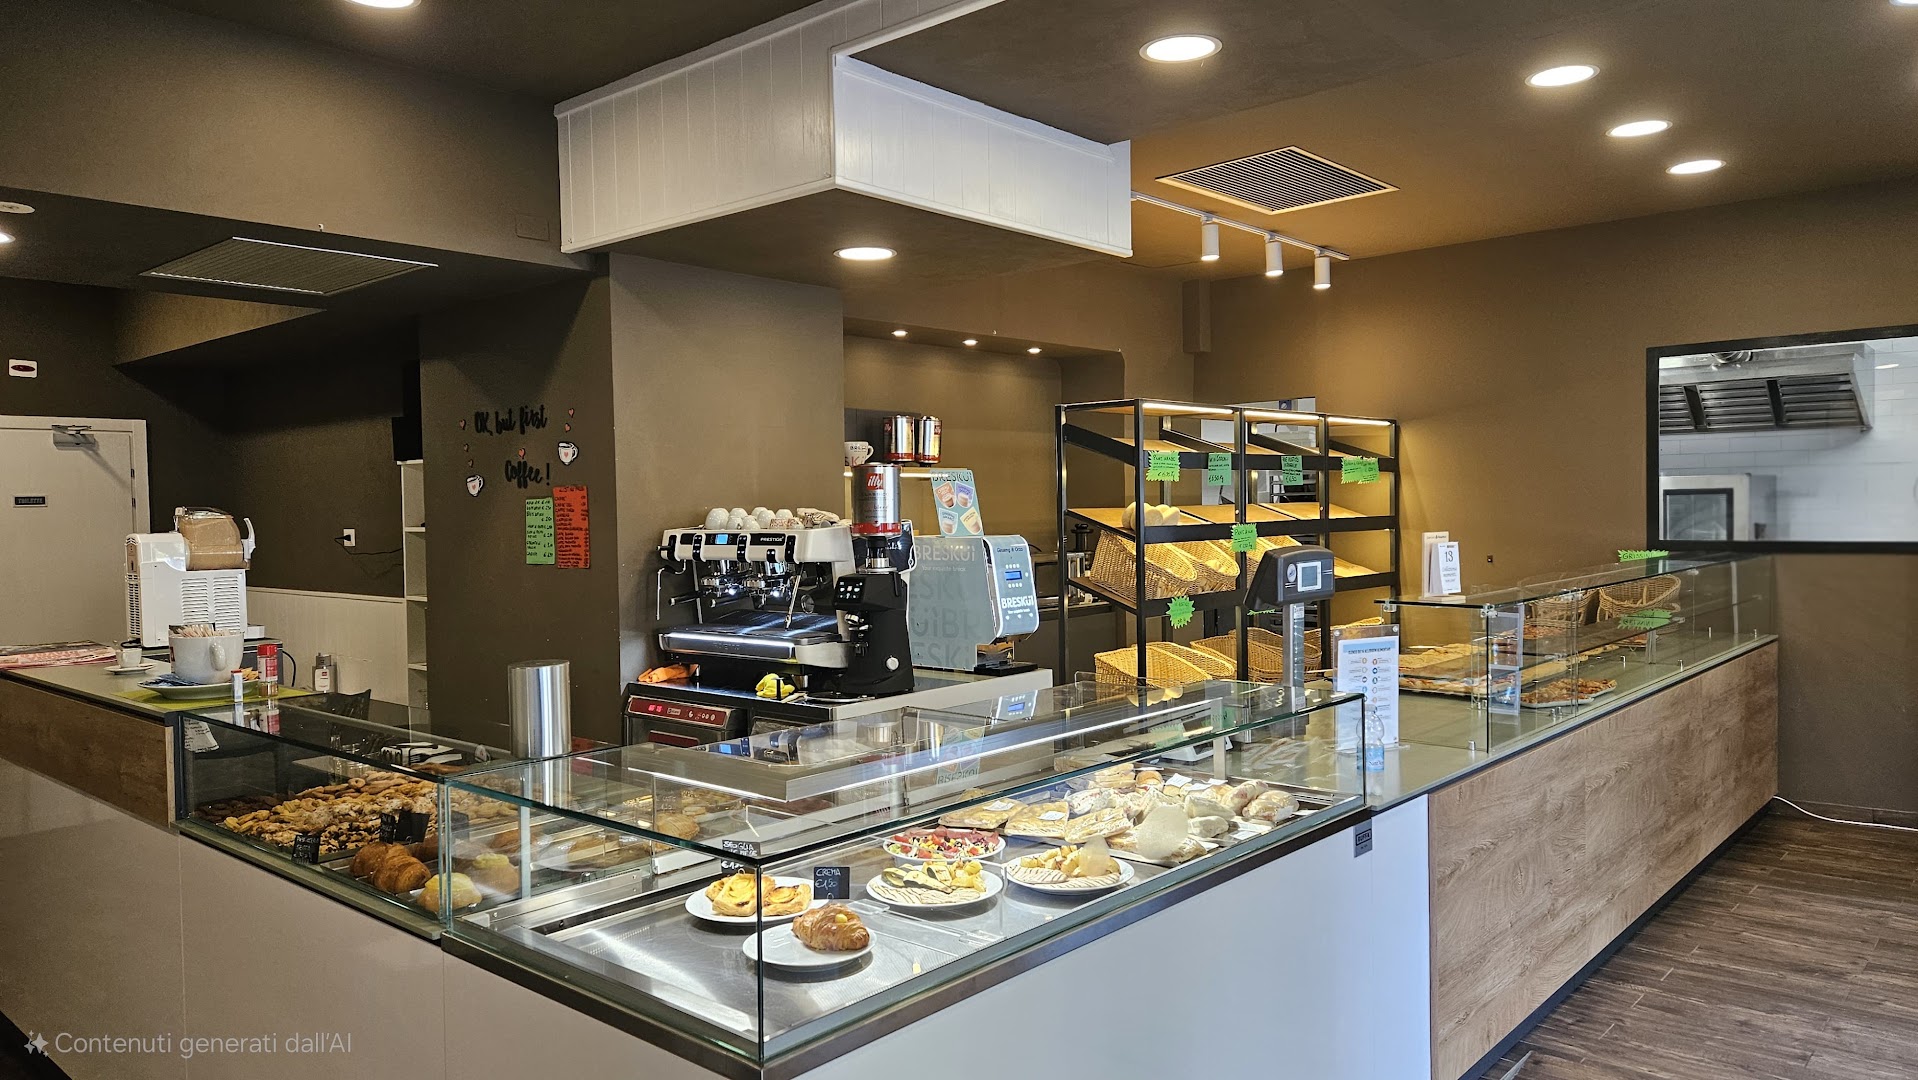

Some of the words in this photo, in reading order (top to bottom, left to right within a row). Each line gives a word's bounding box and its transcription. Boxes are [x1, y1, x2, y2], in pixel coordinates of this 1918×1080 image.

[495, 408, 516, 435] but
[520, 404, 548, 435] first
[505, 460, 543, 489] Coffee
[867, 475, 883, 490] illy
[1444, 550, 1454, 562] 13
[816, 868, 841, 877] CREMA
